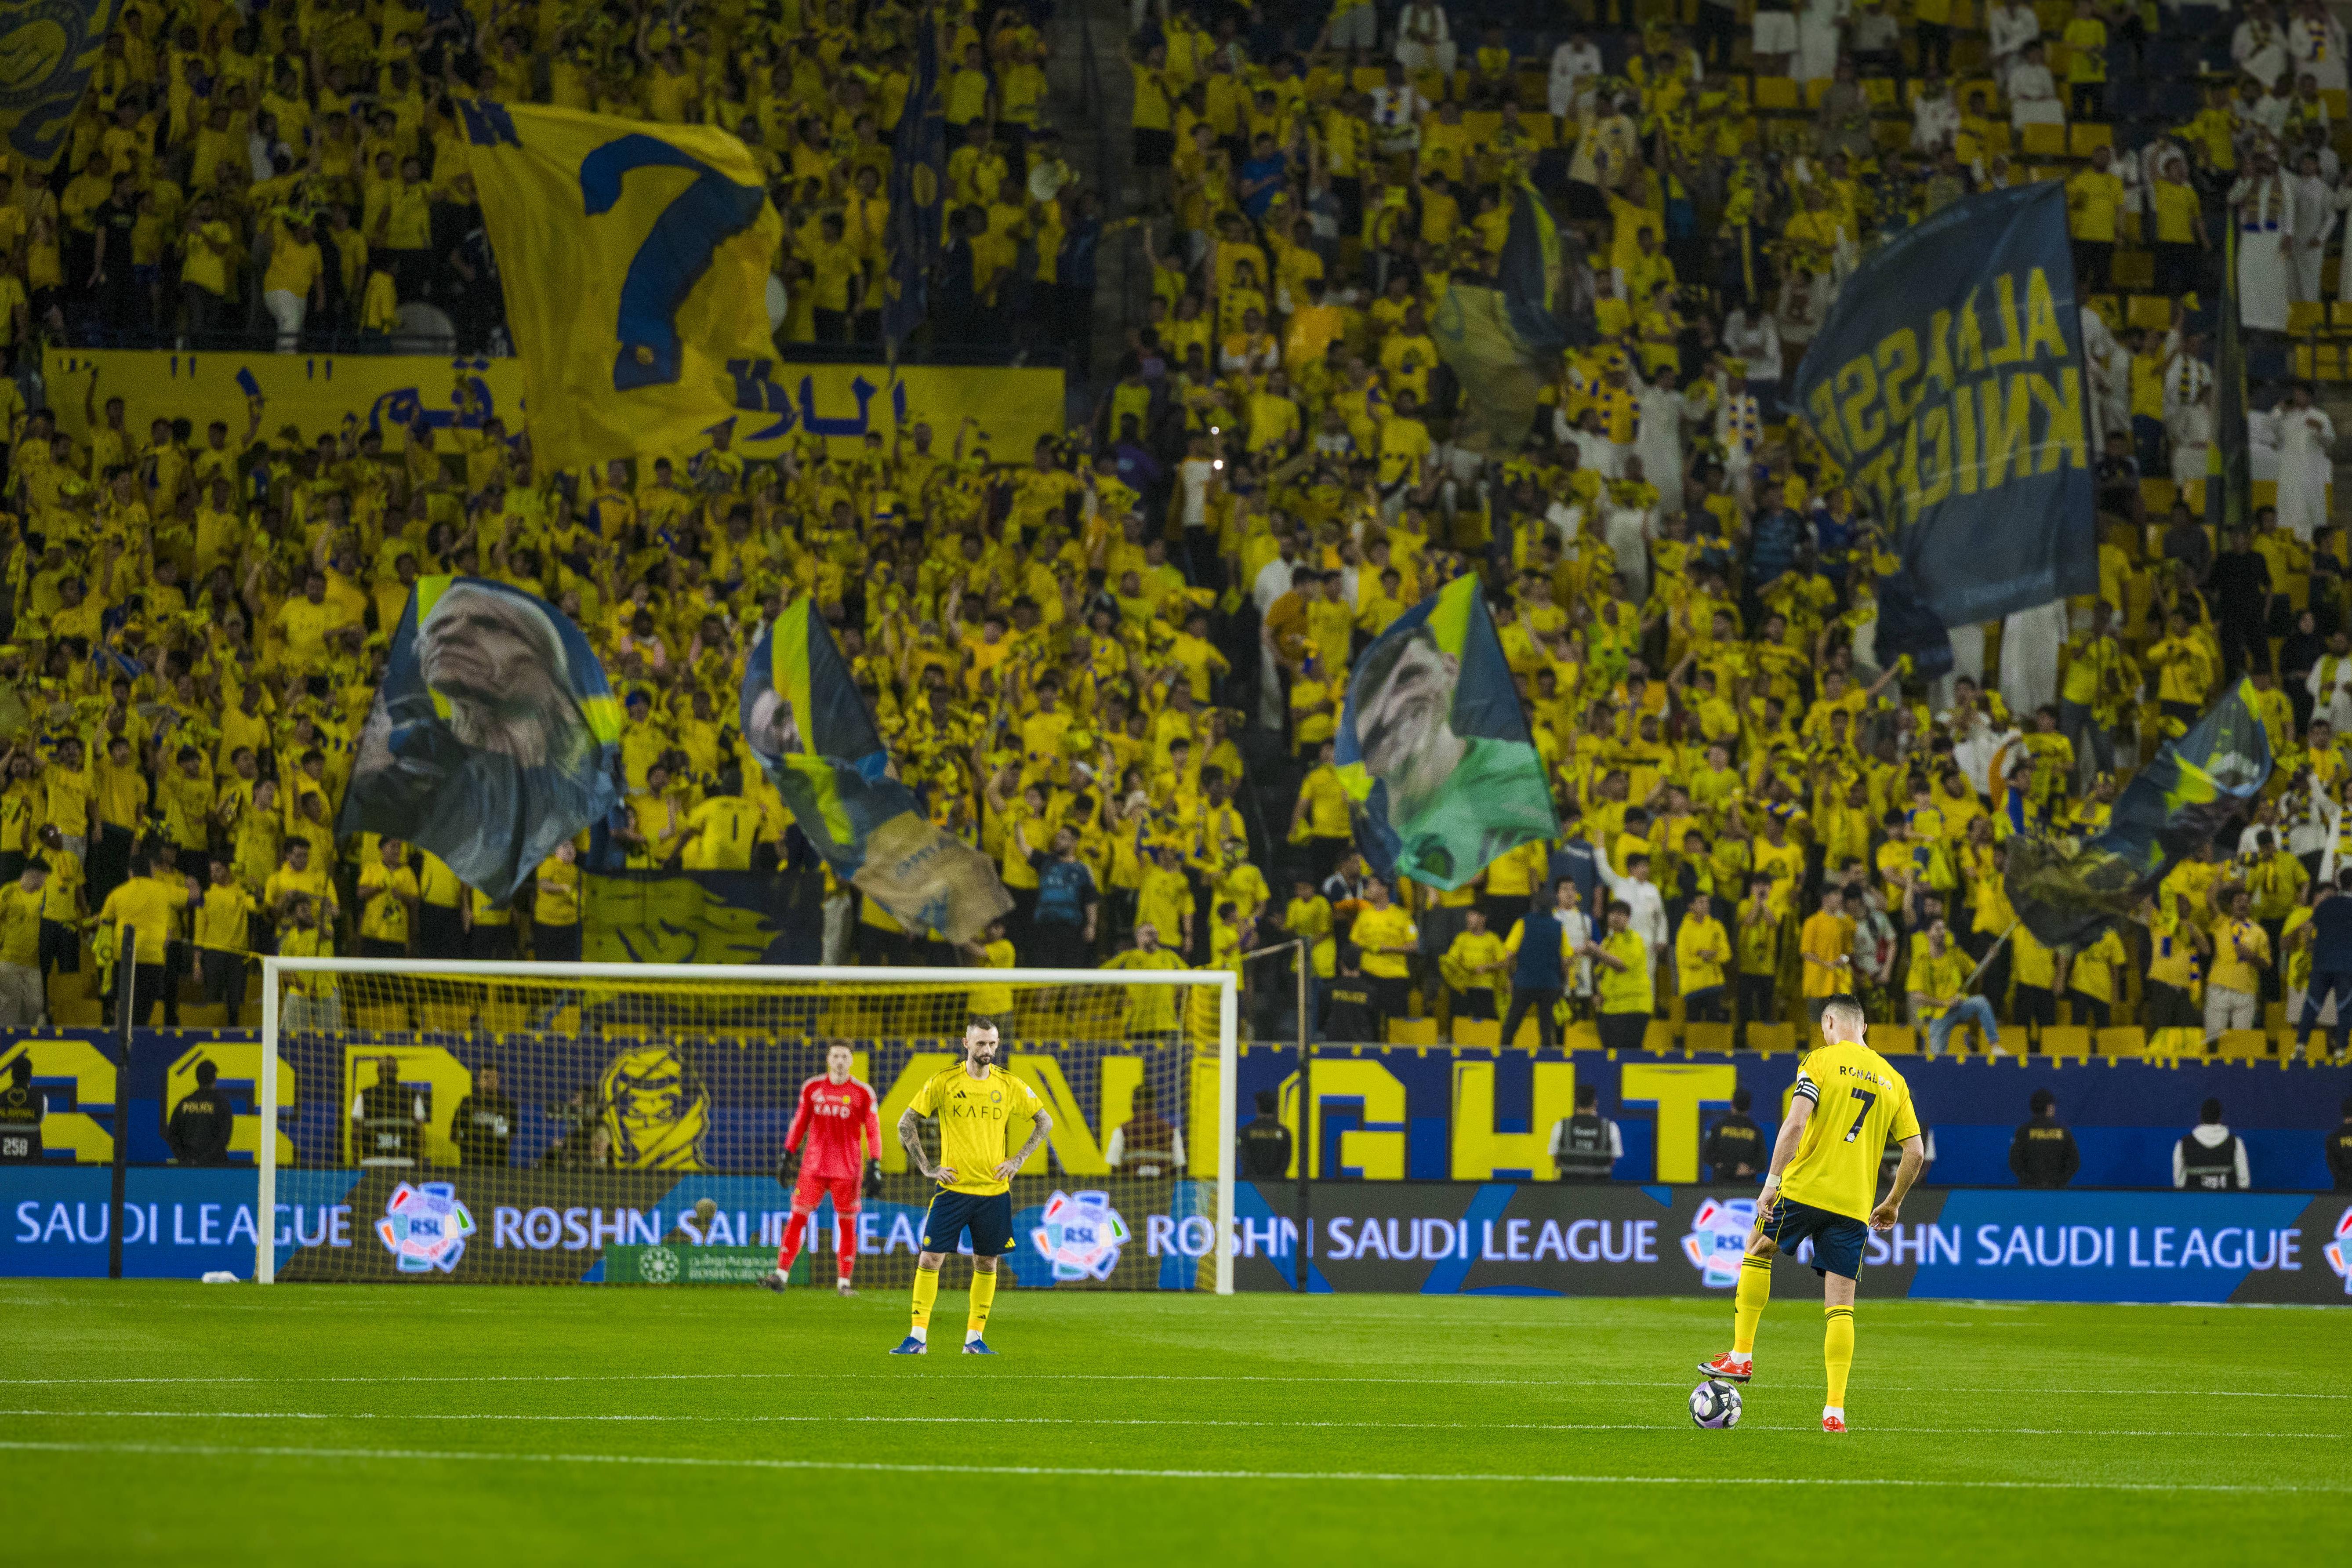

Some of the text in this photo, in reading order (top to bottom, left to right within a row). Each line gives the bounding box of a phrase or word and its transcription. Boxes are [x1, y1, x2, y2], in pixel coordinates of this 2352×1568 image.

[1840, 1065, 1892, 1090] RONALDO
[182, 1100, 214, 1114] POLICE
[814, 1104, 851, 1119] KAFD
[953, 1104, 1002, 1120] KAFD
[1843, 1087, 1877, 1143] 7
[1720, 1126, 1756, 1141] POLICE
[2029, 1128, 2064, 1140] POLICE
[18, 1201, 352, 1247] SAUDI LEAGUE
[410, 1218, 442, 1236] RSL
[494, 1207, 661, 1249] ROSHN
[1065, 1227, 1095, 1243] RSL
[1327, 1216, 1468, 1260] SAUDI
[1481, 1218, 1659, 1263] LEAGUE
[1716, 1234, 1744, 1250] RSL
[1797, 1223, 2302, 1270] SHN SAUDI LEAGUE
